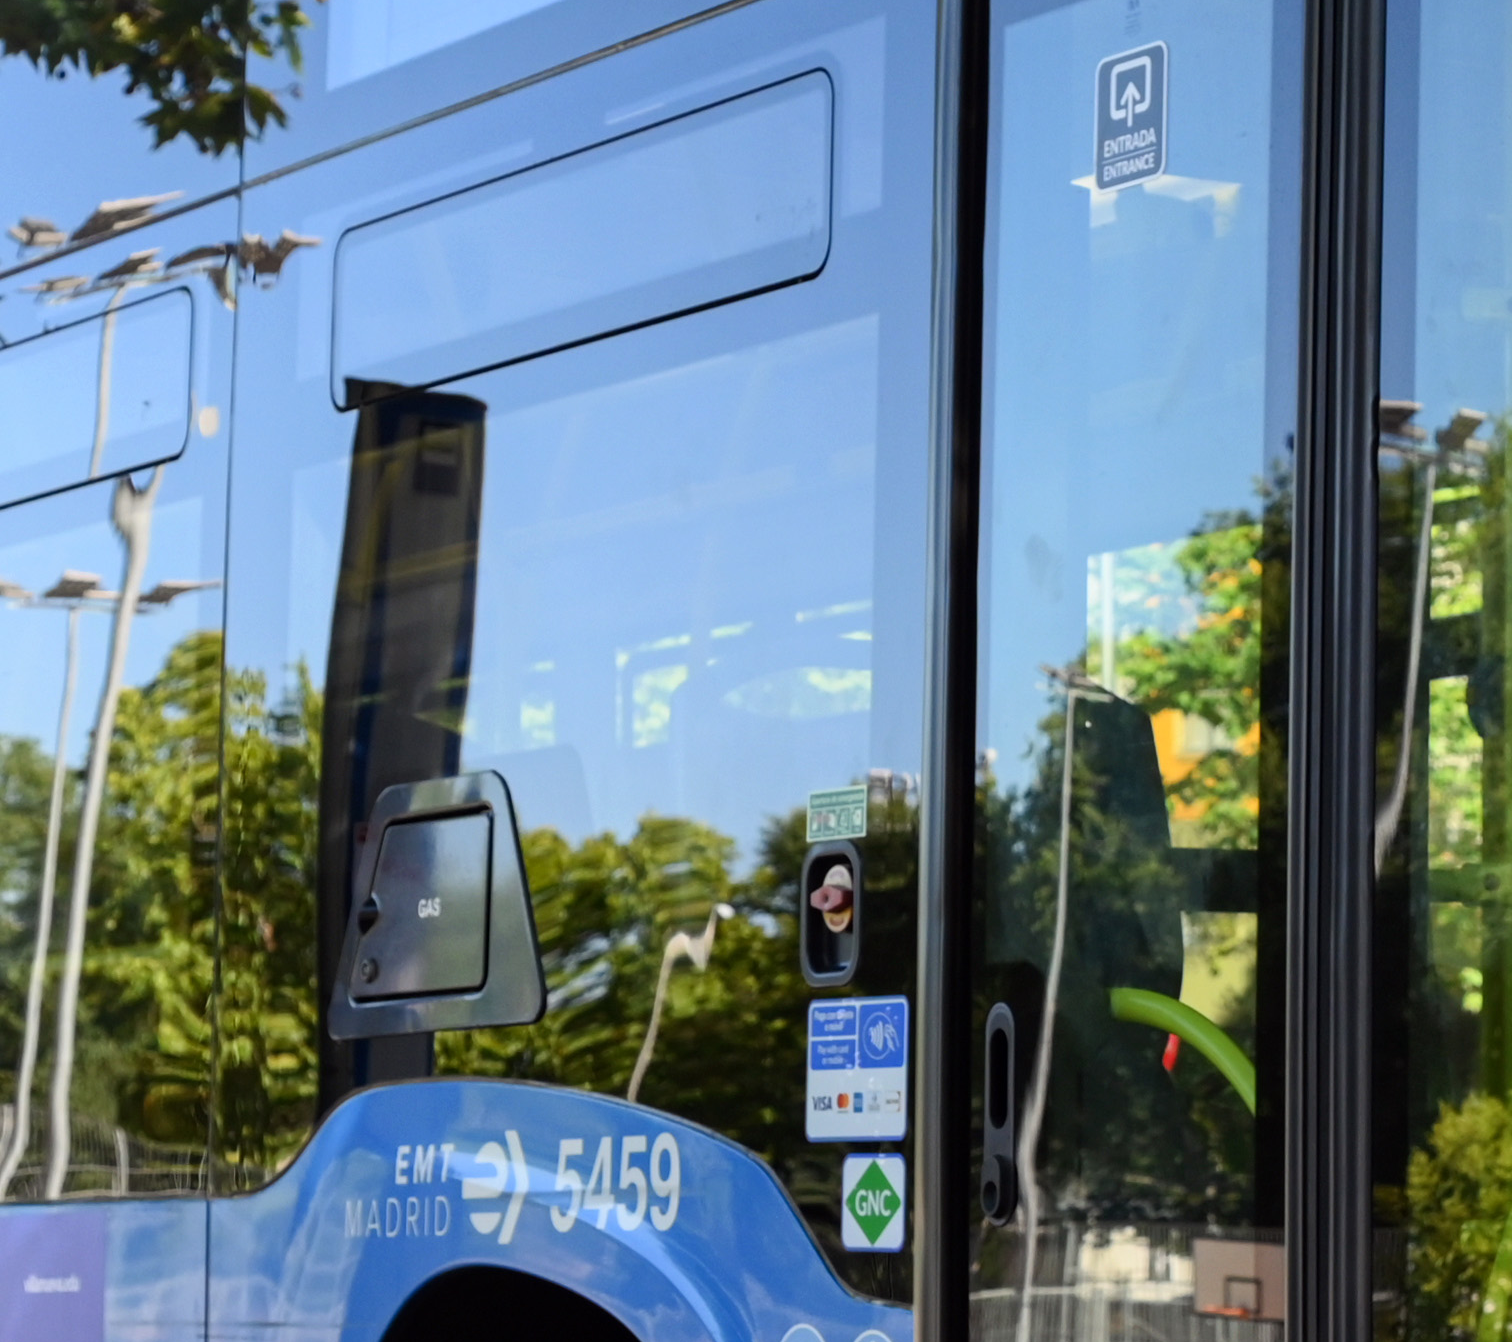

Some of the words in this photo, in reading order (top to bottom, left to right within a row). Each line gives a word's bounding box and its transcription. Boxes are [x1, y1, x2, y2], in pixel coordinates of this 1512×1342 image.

[1103, 127, 1157, 158] ENTRADA
[1103, 152, 1155, 182] ENTRANCE
[418, 897, 442, 919] GAS
[812, 1096, 833, 1111] VISA
[395, 1143, 454, 1187] EMT
[549, 1131, 681, 1234] 5459
[344, 1195, 451, 1239] MADRID
[854, 1188, 892, 1217] GNC
